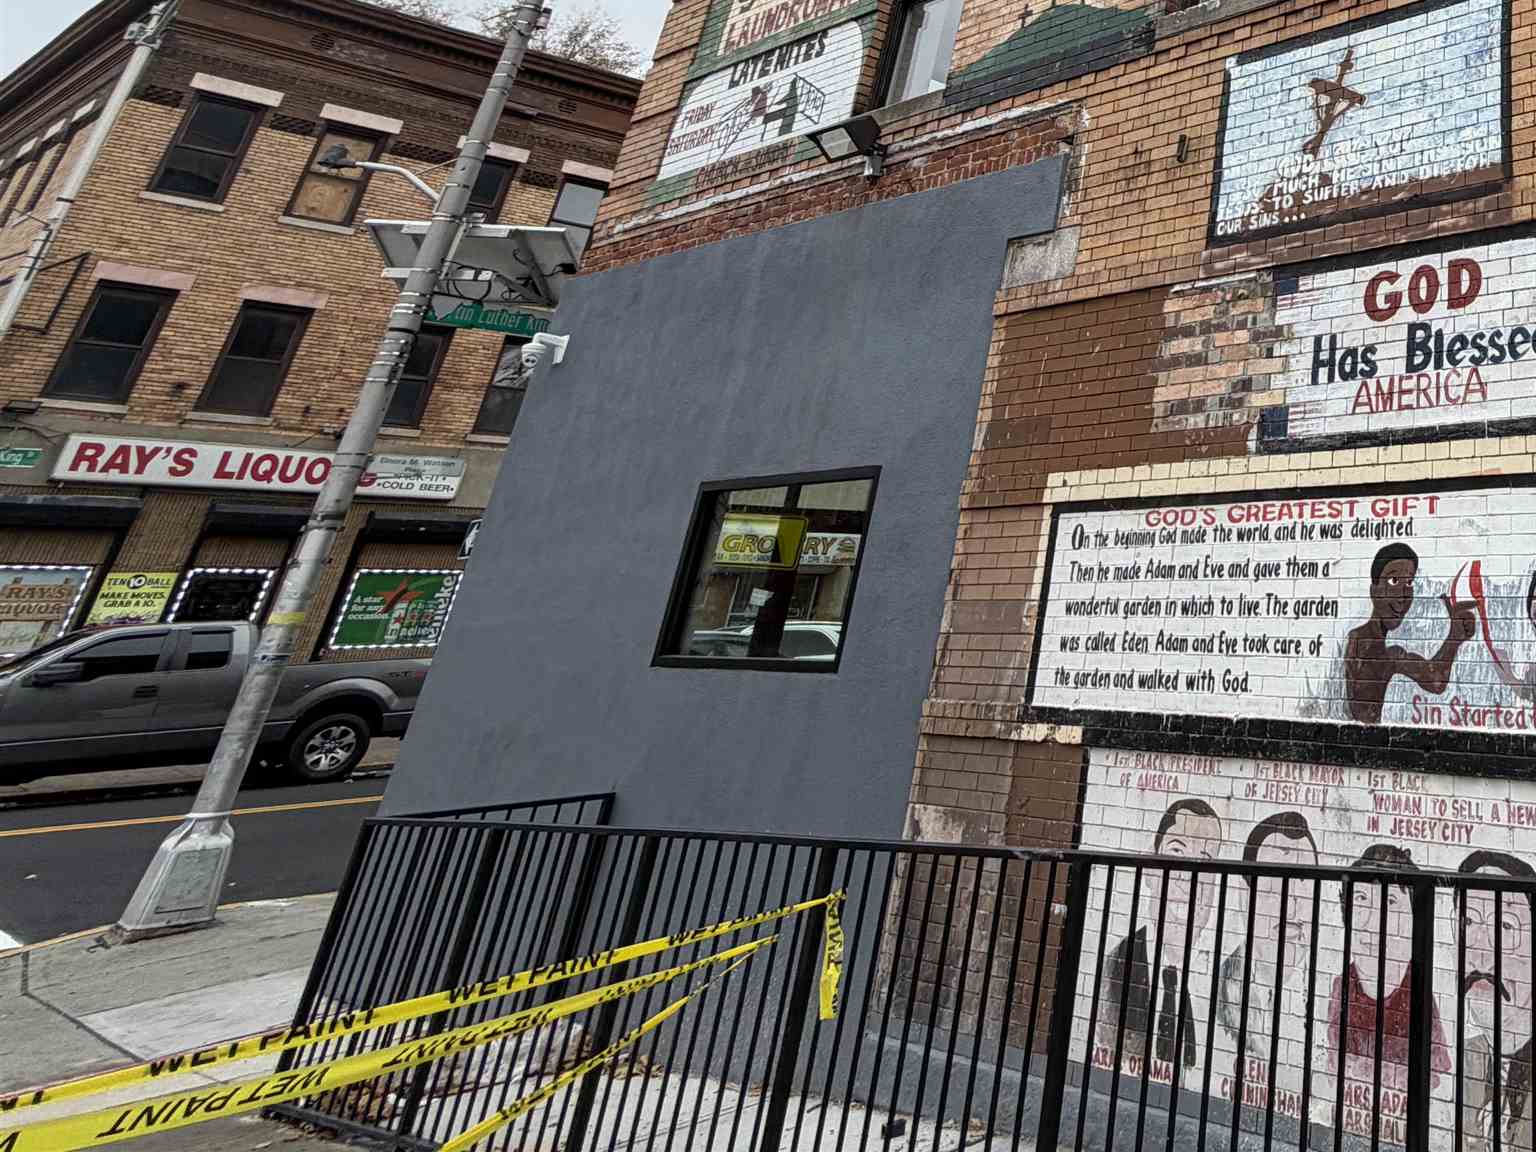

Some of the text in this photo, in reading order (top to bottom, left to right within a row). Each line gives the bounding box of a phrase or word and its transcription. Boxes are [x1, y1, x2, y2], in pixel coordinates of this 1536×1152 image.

[1302, 183, 1360, 204] SUFFER
[1364, 258, 1482, 322] GOD
[1312, 334, 1378, 385] Has
[1352, 367, 1488, 414] AMERICA
[69, 442, 198, 477] RAY'S
[382, 481, 414, 489] COLD
[1146, 496, 1440, 527] GOD'S GREATEST GIFT
[1071, 519, 1343, 549] On the beginning God made the and he was
[129, 576, 145, 587] 10
[1070, 557, 1330, 582] Then he made Adam and Eve and gave them a
[104, 600, 131, 608] GRAB
[1065, 593, 1338, 619] wonderful garden in which to The garden
[1059, 628, 1322, 657] was called Adam and Eve took of
[1054, 668, 1252, 694] the garden and walked with God.
[1411, 696, 1443, 725] Sin
[1449, 698, 1526, 729] Started
[1135, 752, 1223, 775] BLACK PRESIDENT
[1273, 764, 1345, 785] BLACK MAYOR
[1119, 773, 1179, 791] OF AMERICA
[1245, 782, 1328, 808] OF JERSEY CITY
[1392, 773, 1427, 792] BLACK
[1373, 794, 1421, 816] WOMAN
[1433, 800, 1447, 817] TO
[1452, 801, 1483, 821] SELL
[1491, 803, 1500, 822] A
[1367, 817, 1474, 844] IN JERSEY CITY
[238, 1066, 330, 1106] WET
[97, 1085, 240, 1138] PAINT
